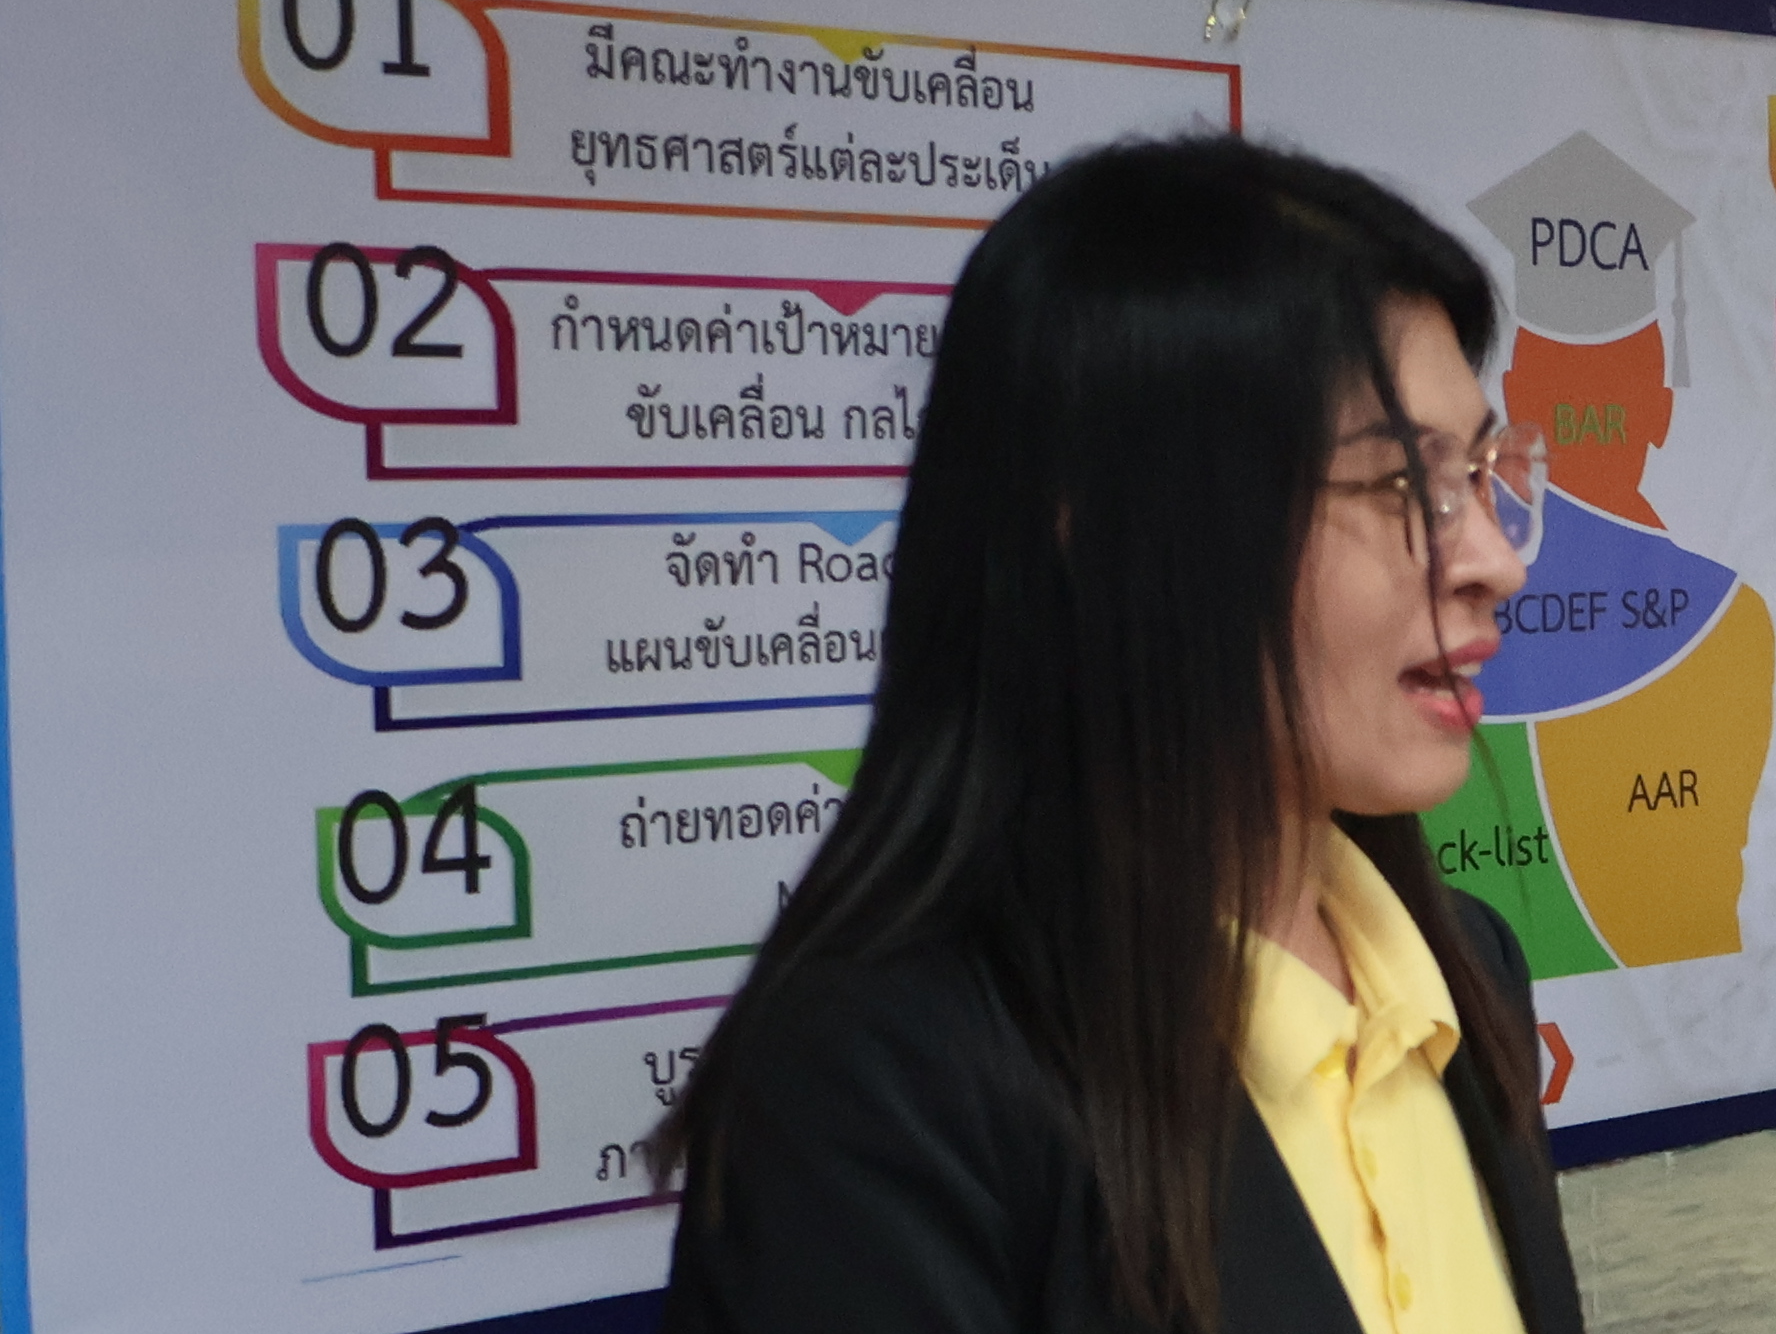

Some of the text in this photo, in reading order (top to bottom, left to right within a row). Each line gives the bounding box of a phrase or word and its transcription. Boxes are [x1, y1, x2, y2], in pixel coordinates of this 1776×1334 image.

[584, 24, 1036, 114] มีคณะทำงานขับเคลื่อน
[1530, 217, 1649, 272] PDCA
[305, 242, 463, 357] 02
[627, 373, 825, 441] ขับเคลื่อน
[1554, 404, 1627, 447] BAR
[315, 515, 469, 633] 03
[665, 531, 780, 589] จัดทำ
[606, 601, 884, 674] แผนขับเคลื่อน
[1497, 588, 1690, 634] BCDEF S&P
[1627, 769, 1700, 813] AAR
[338, 783, 492, 905] 04
[1437, 825, 1549, 875] ck-list
[340, 1013, 493, 1138] 05
